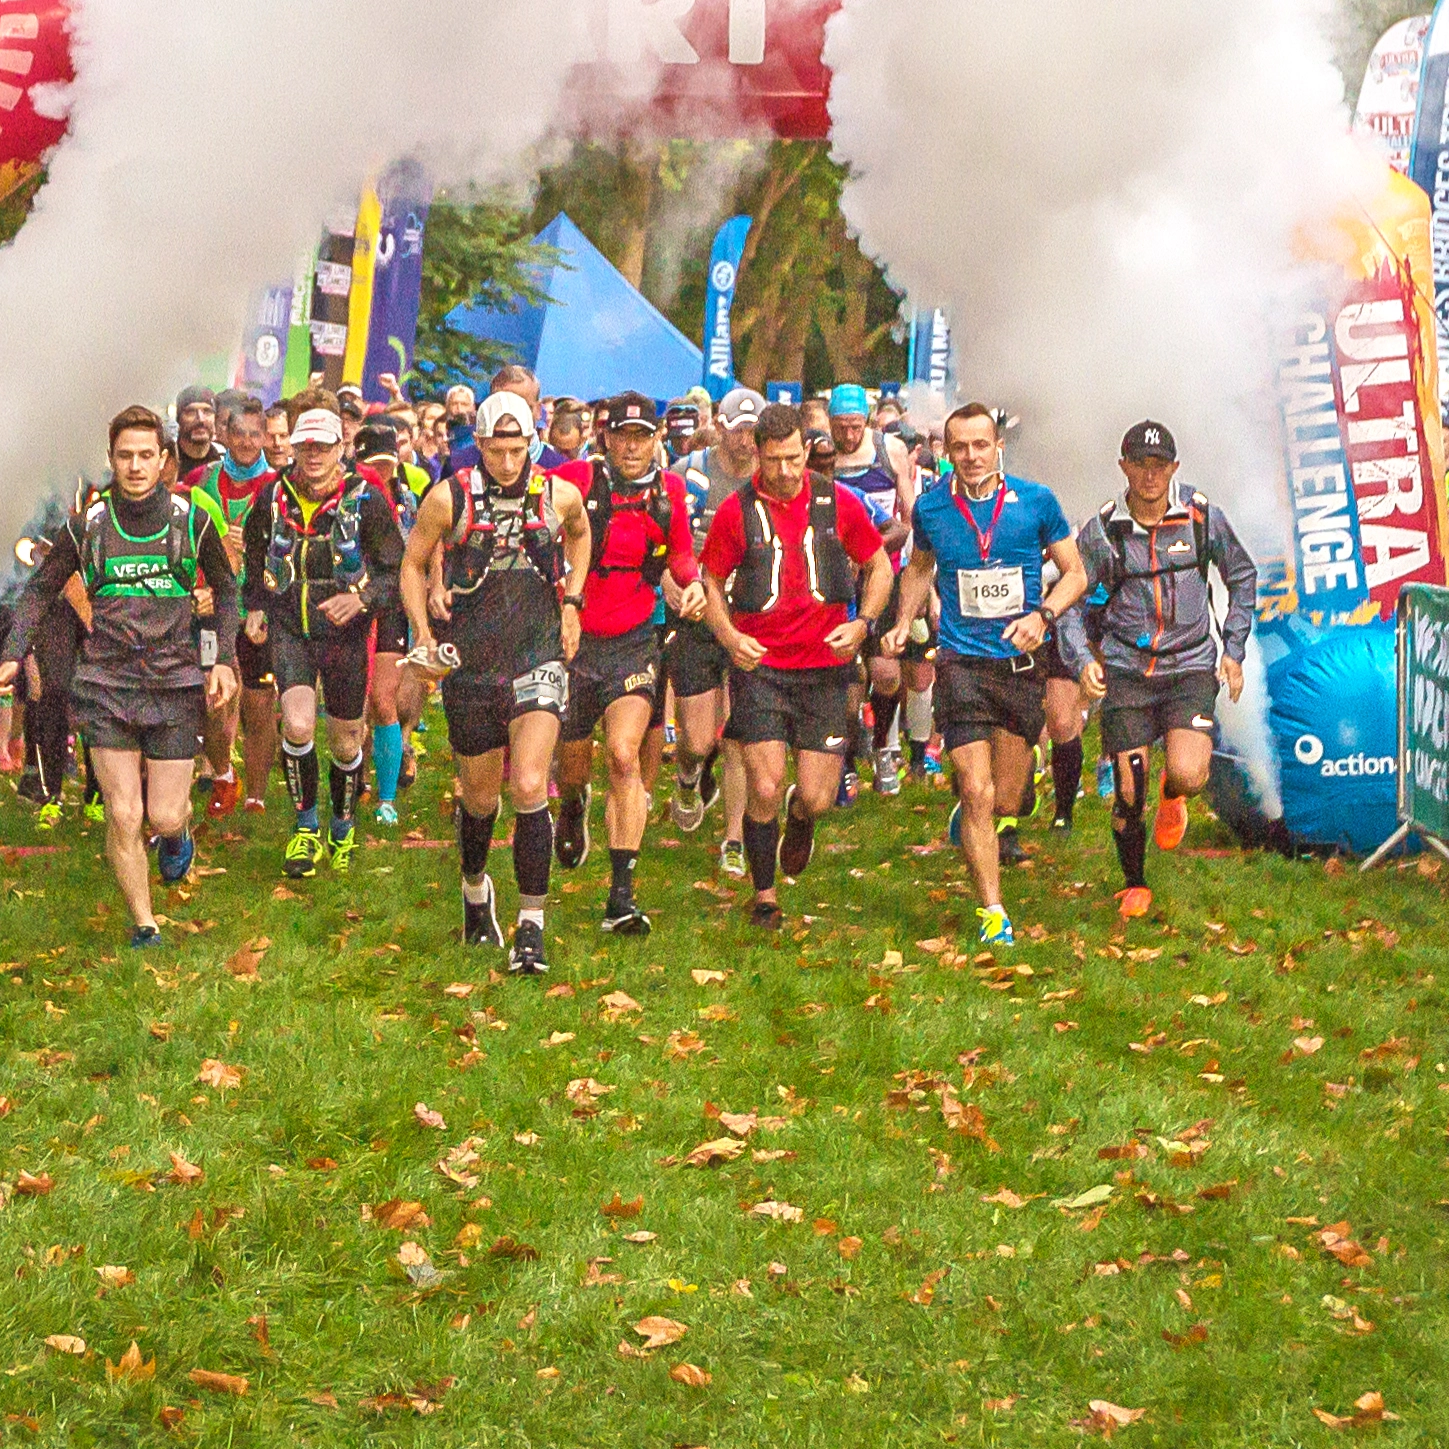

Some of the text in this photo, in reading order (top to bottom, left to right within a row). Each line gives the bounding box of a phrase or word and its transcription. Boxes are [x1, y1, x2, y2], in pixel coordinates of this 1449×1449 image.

[1279, 311, 1358, 596] CHALLENGE
[1335, 298, 1431, 589] ULTRA
[972, 583, 1010, 600] 1635
